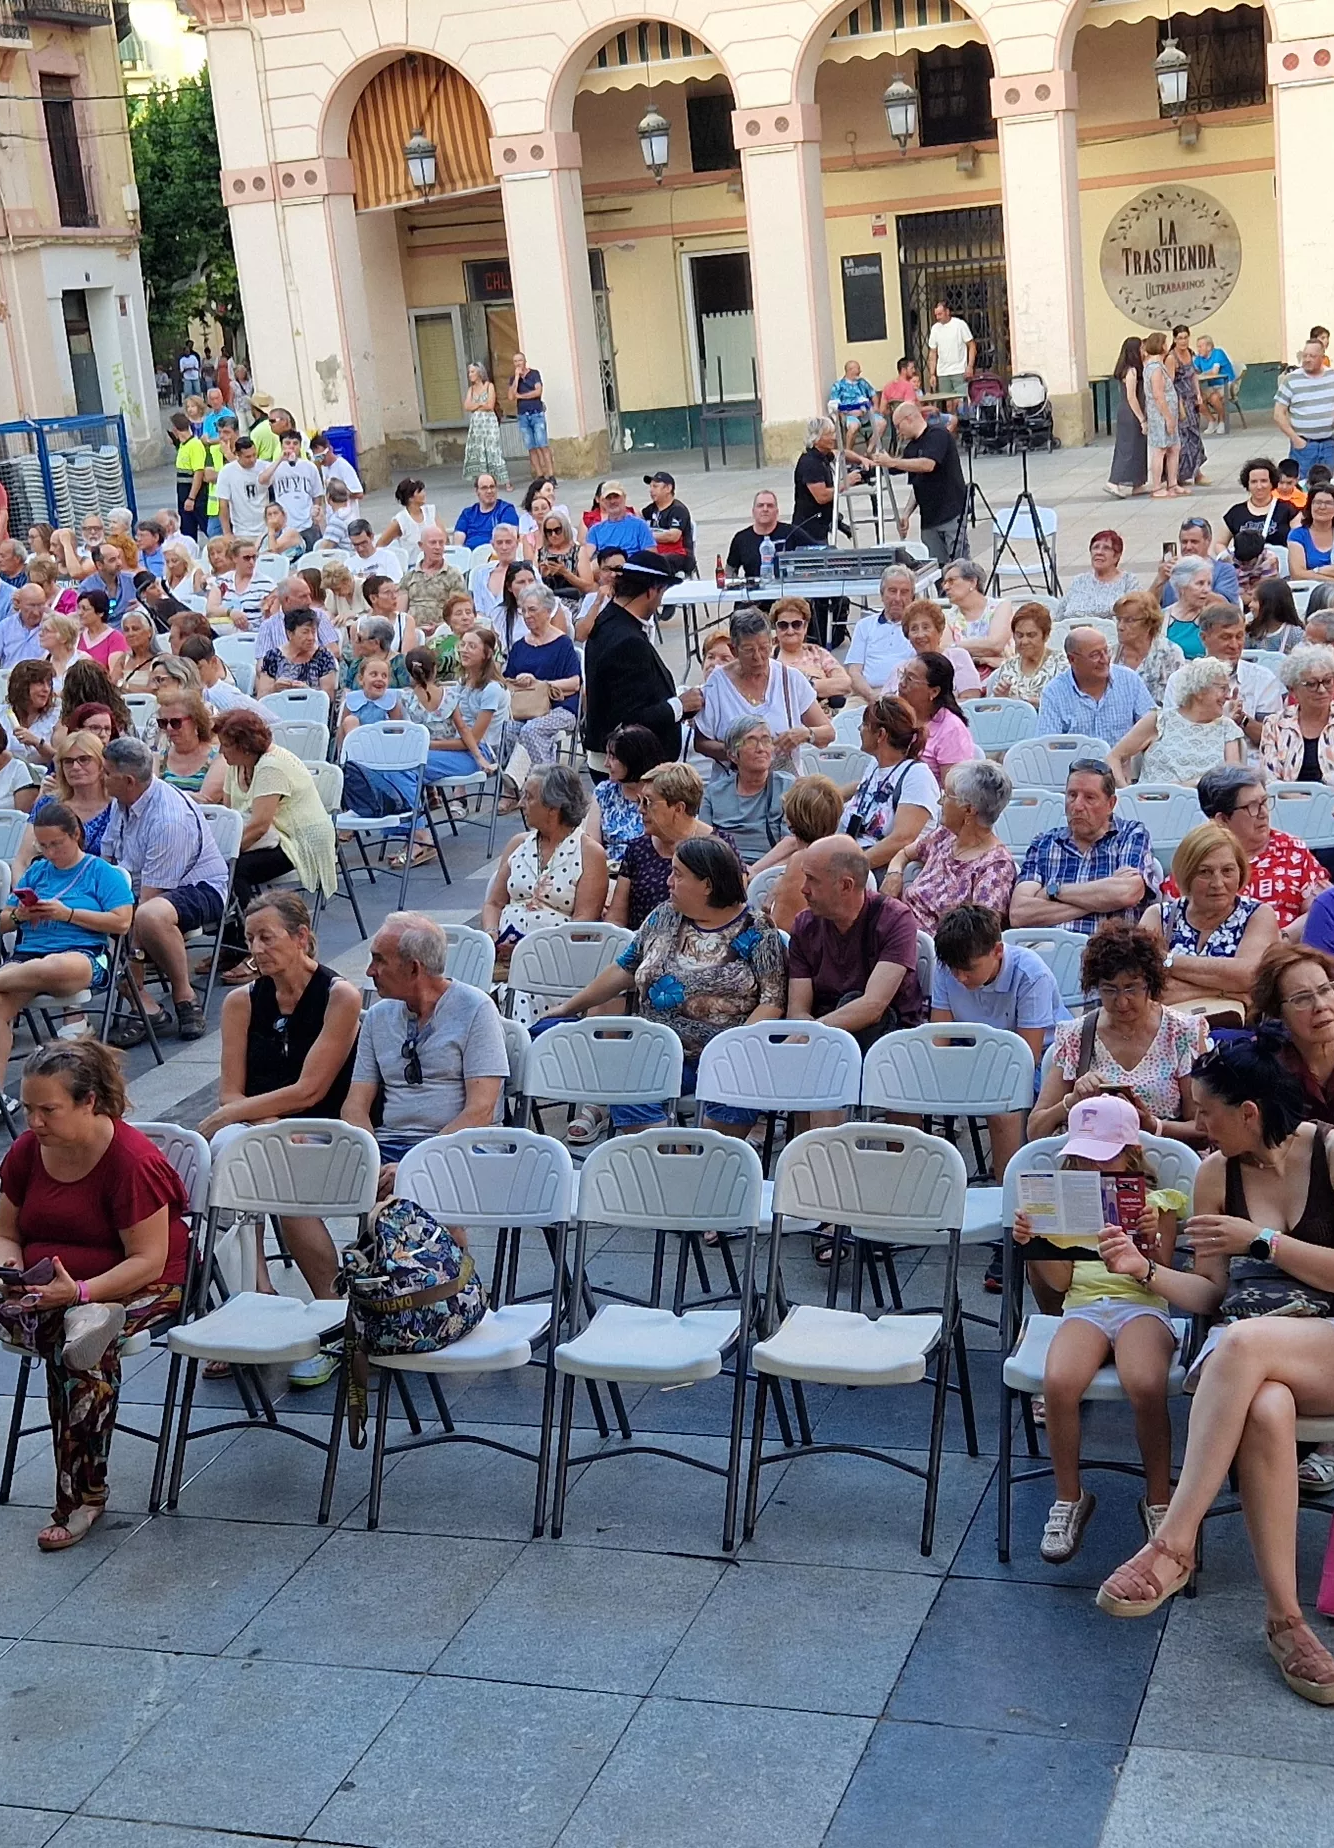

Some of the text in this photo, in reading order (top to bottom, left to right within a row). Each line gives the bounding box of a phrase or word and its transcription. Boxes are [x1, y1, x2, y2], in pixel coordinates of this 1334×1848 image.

[1158, 217, 1178, 247] LA
[1122, 243, 1217, 276] TRASTIENDA
[484, 271, 513, 291] CAL
